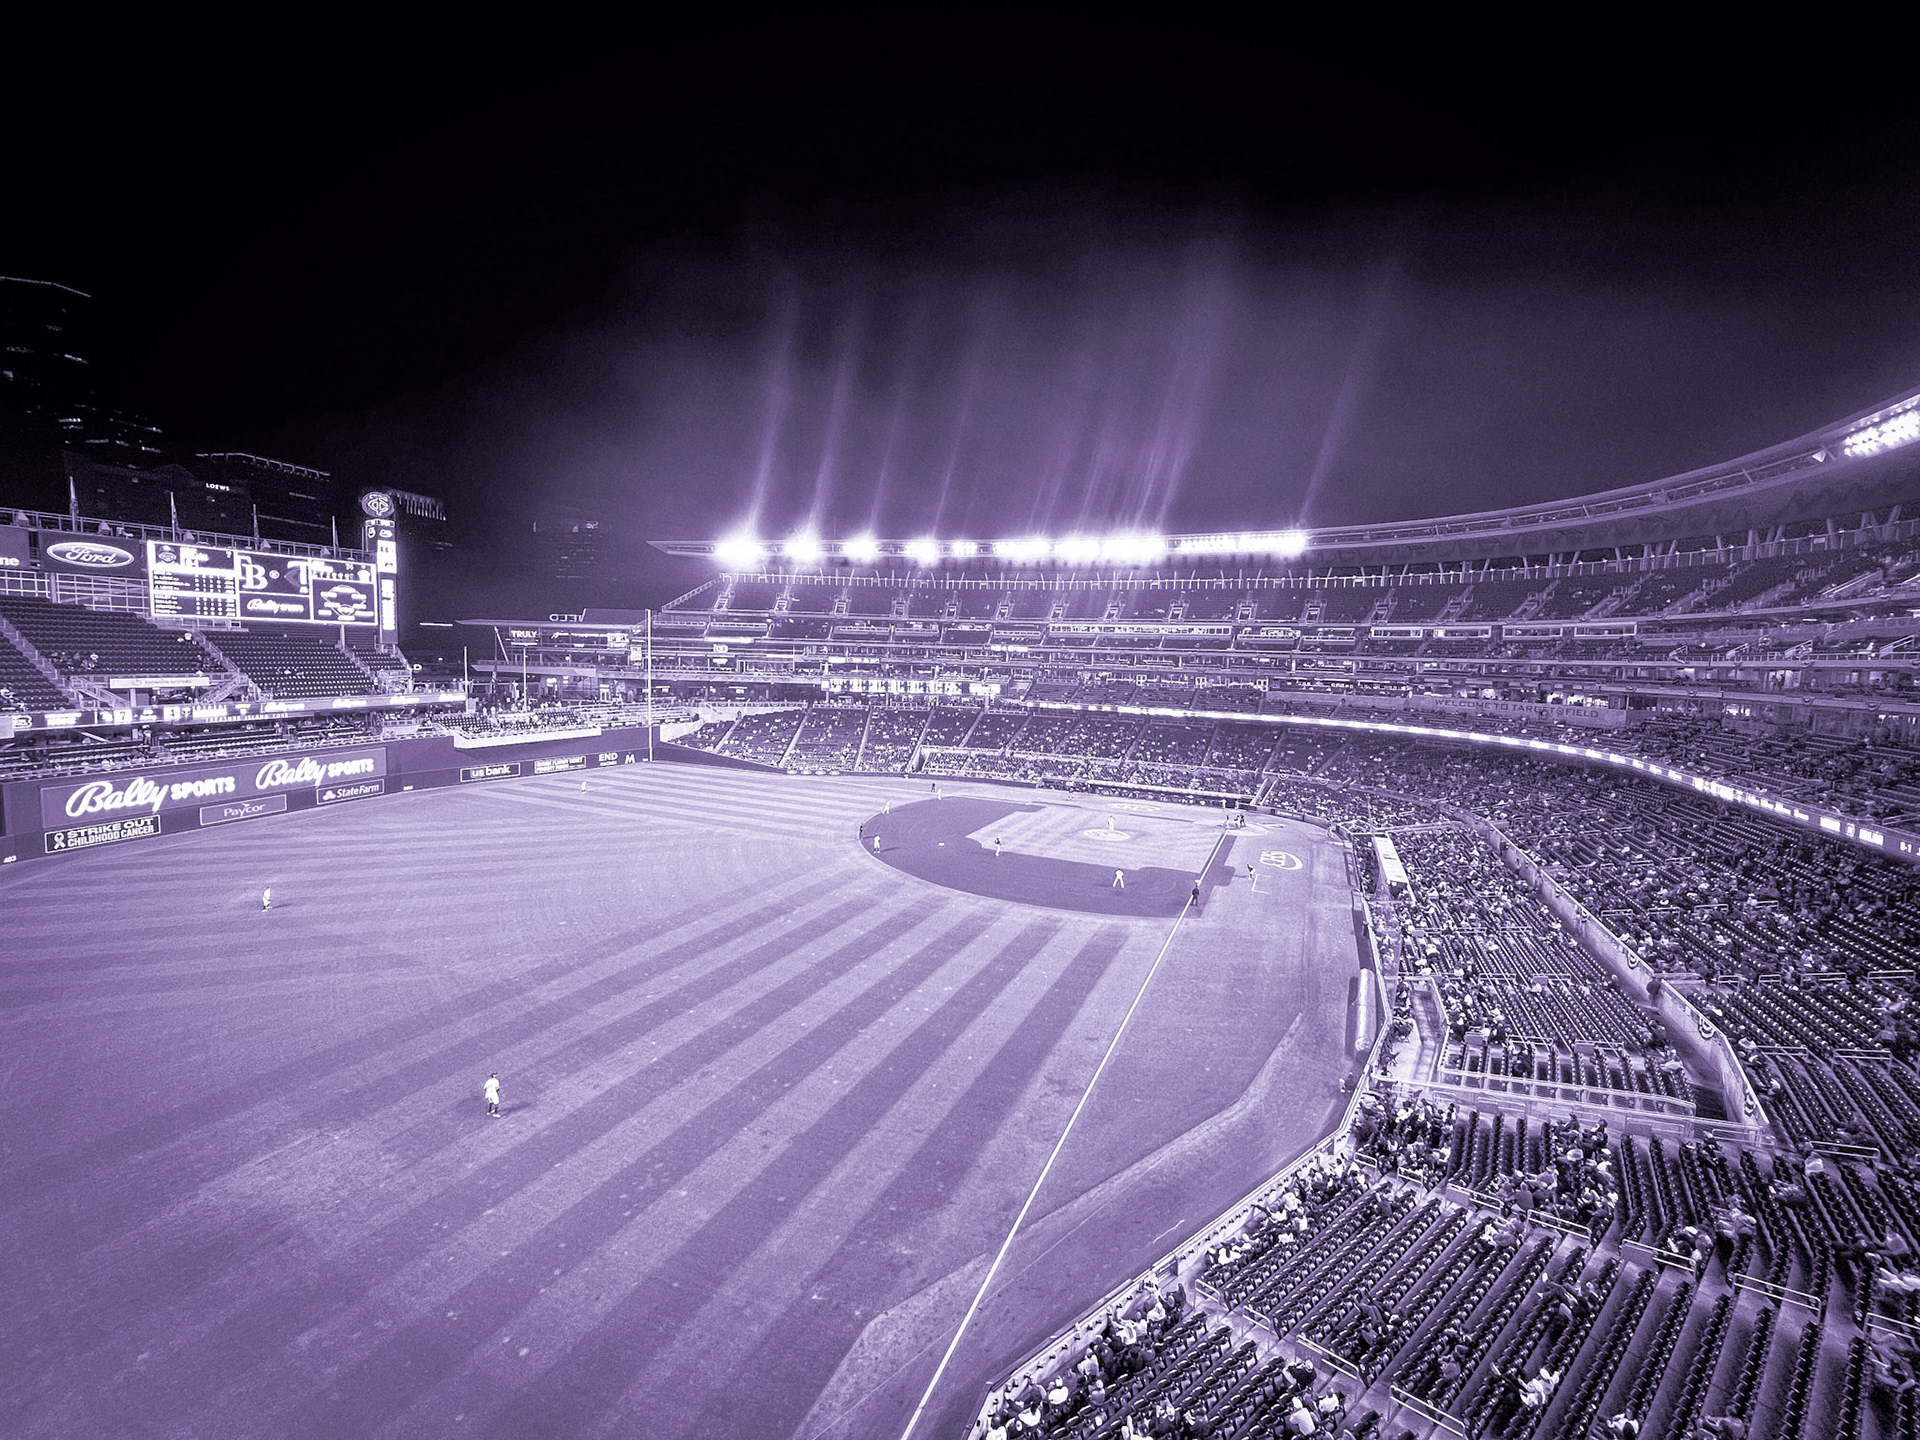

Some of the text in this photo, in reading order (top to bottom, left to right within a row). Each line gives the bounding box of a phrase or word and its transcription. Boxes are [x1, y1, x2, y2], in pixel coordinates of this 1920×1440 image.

[205, 482, 230, 491] LOEWS
[65, 545, 116, 564] Ford
[510, 630, 538, 638] TRULY
[1434, 699, 1492, 709] WELCOME
[1512, 704, 1554, 715] TARGET
[1565, 709, 1599, 718] FIELD
[205, 715, 241, 723] TREASURE
[244, 713, 269, 721] ISLAND
[598, 752, 618, 762] END
[255, 756, 374, 790] Bally SPORTS
[472, 764, 511, 778] us bank
[65, 776, 236, 817] Bally SPORTS
[223, 802, 266, 818] Paycor
[67, 817, 154, 838] STRIKE OUT
[67, 824, 154, 848] CHILDHOOD CANCER
